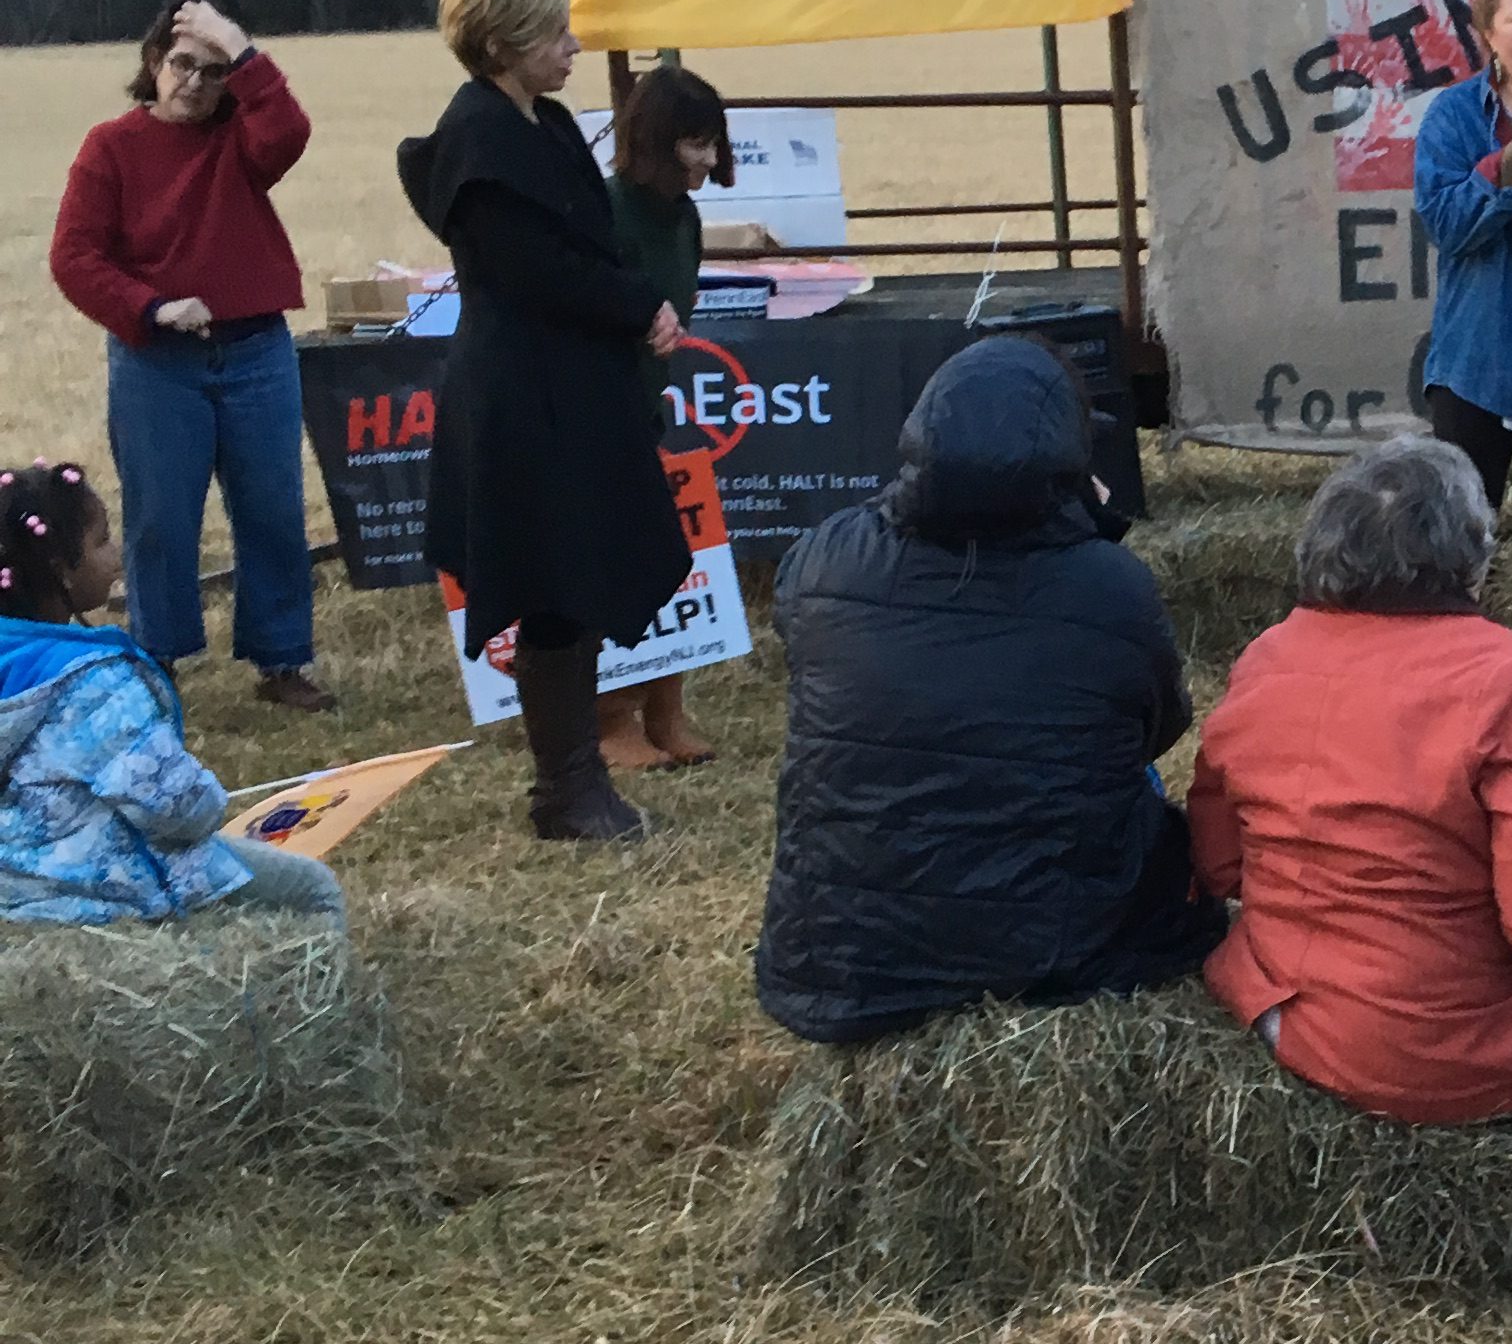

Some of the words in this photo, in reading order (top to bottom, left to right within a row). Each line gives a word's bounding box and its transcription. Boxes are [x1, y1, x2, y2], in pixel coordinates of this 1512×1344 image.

[347, 390, 436, 451] HA
[661, 372, 832, 425] nEast
[1255, 363, 1385, 432] for
[779, 473, 826, 490] HALT
[830, 474, 846, 489] is
[848, 474, 880, 489] not
[642, 593, 718, 642] LP!
